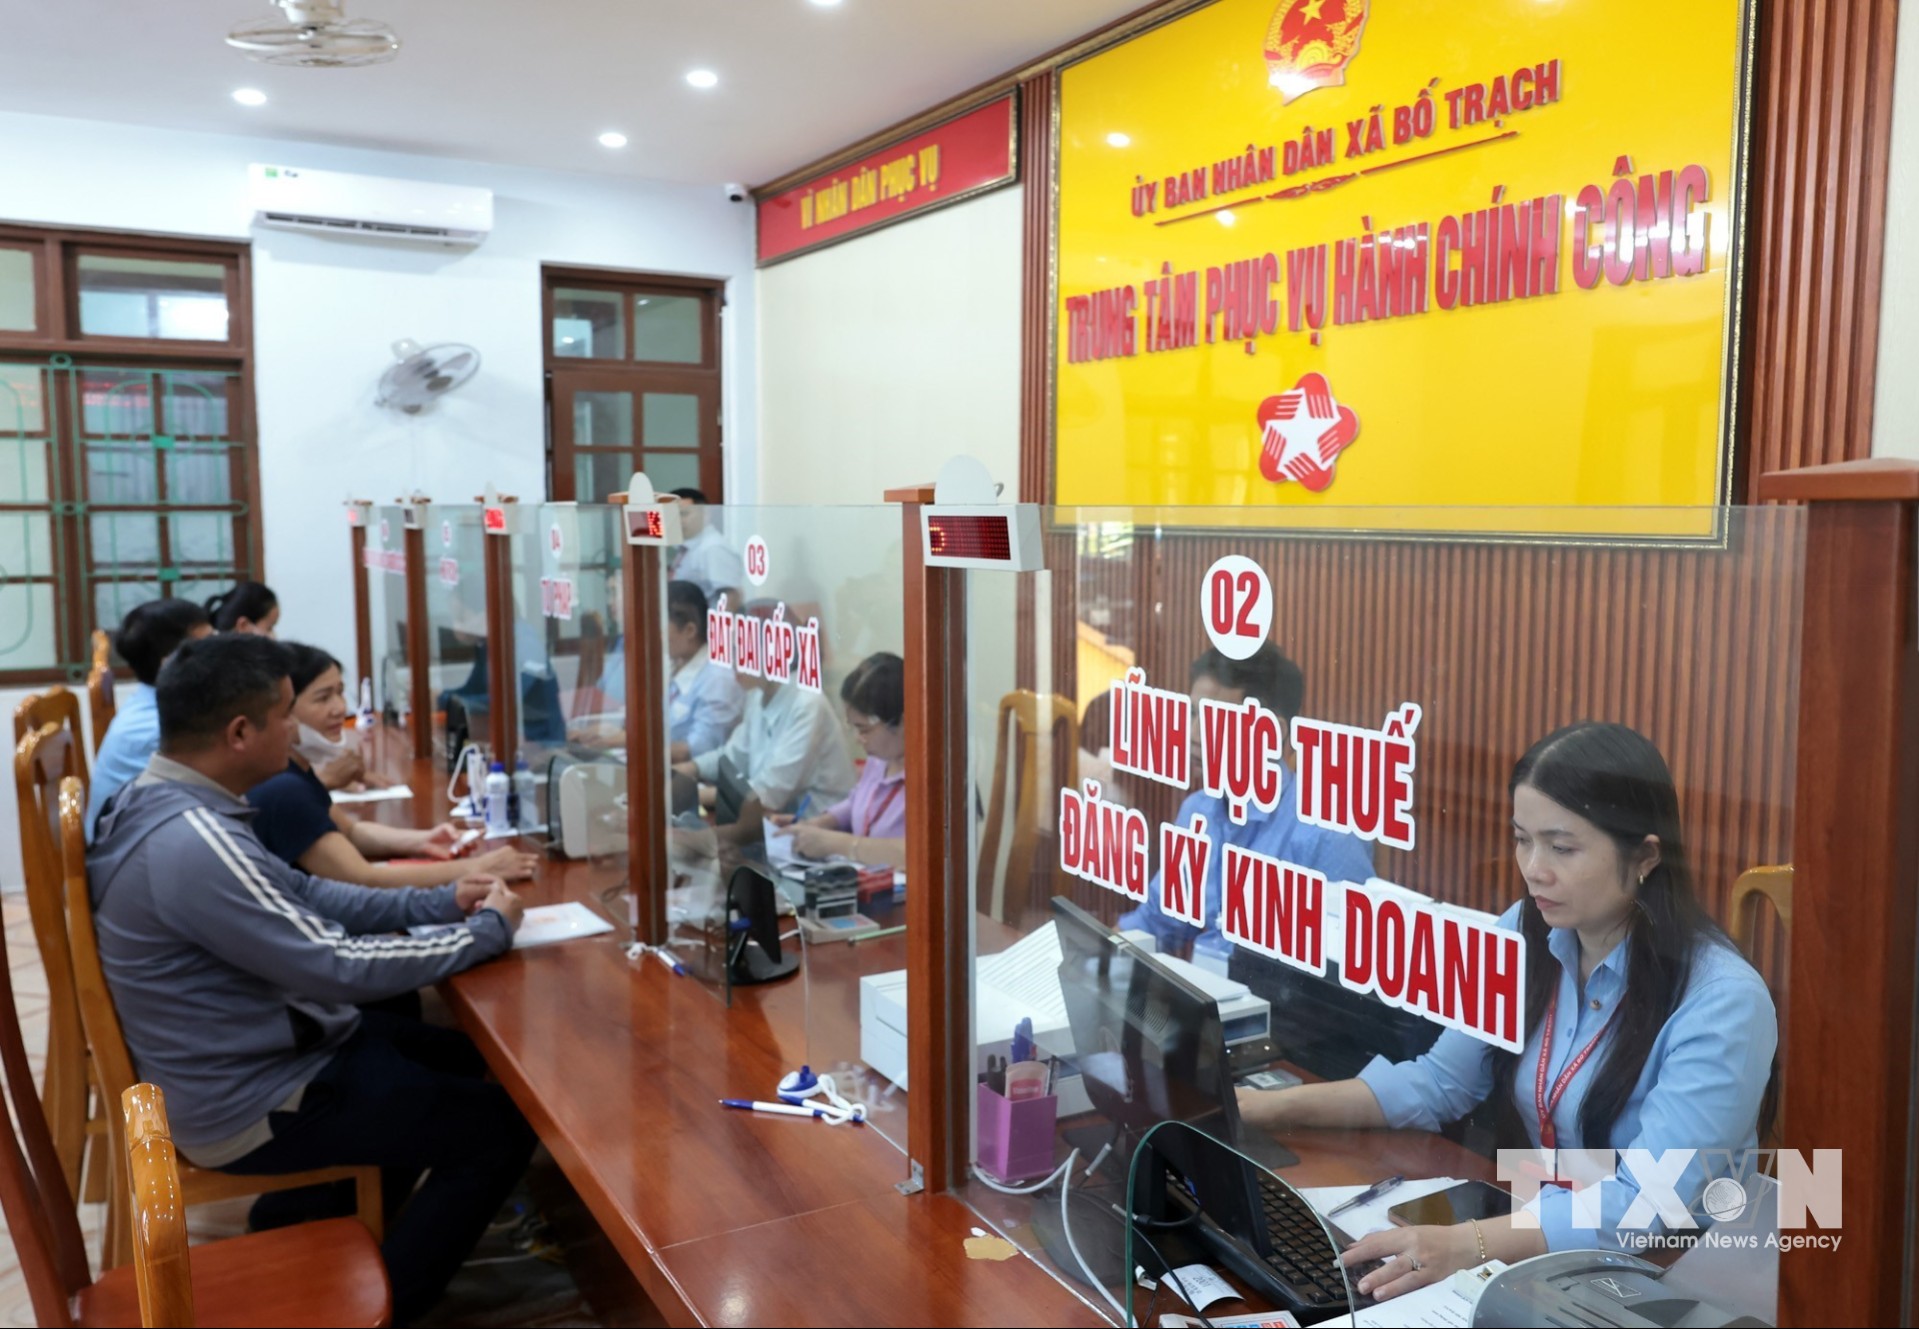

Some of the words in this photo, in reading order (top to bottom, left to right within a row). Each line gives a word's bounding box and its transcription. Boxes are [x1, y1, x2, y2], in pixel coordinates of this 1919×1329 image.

[1131, 174, 1158, 217] ỦY
[1164, 167, 1206, 208] BAN
[1212, 144, 1275, 195] NHÂN
[1282, 126, 1335, 175] DÂN
[1345, 104, 1385, 158] XÃ
[1393, 77, 1440, 145] BỐ
[1444, 59, 1562, 129] TRẠCH
[1066, 285, 1138, 363] TRUNG
[1144, 261, 1199, 352] TÂM
[1206, 252, 1280, 354] PHỤC
[1287, 243, 1329, 346] VỤ
[1333, 216, 1430, 326] HÀNH
[1435, 185, 1563, 310] CHÍNH
[1572, 155, 1712, 289] CÔNG
[748, 543, 765, 576] 03
[1211, 570, 1260, 638] 02
[708, 595, 732, 664] ĐẤT
[737, 617, 759, 671] ĐAI
[764, 603, 792, 680] CẤP
[798, 621, 819, 689] XÃ
[1112, 671, 1188, 783] LĨNH
[1204, 704, 1278, 819] VỰC
[1296, 710, 1416, 842] THUẾ
[1063, 783, 1145, 896] ĐĂNG
[1163, 820, 1208, 921] KÝ
[1225, 849, 1323, 969] KINH
[1345, 887, 1520, 1044] DOANH
